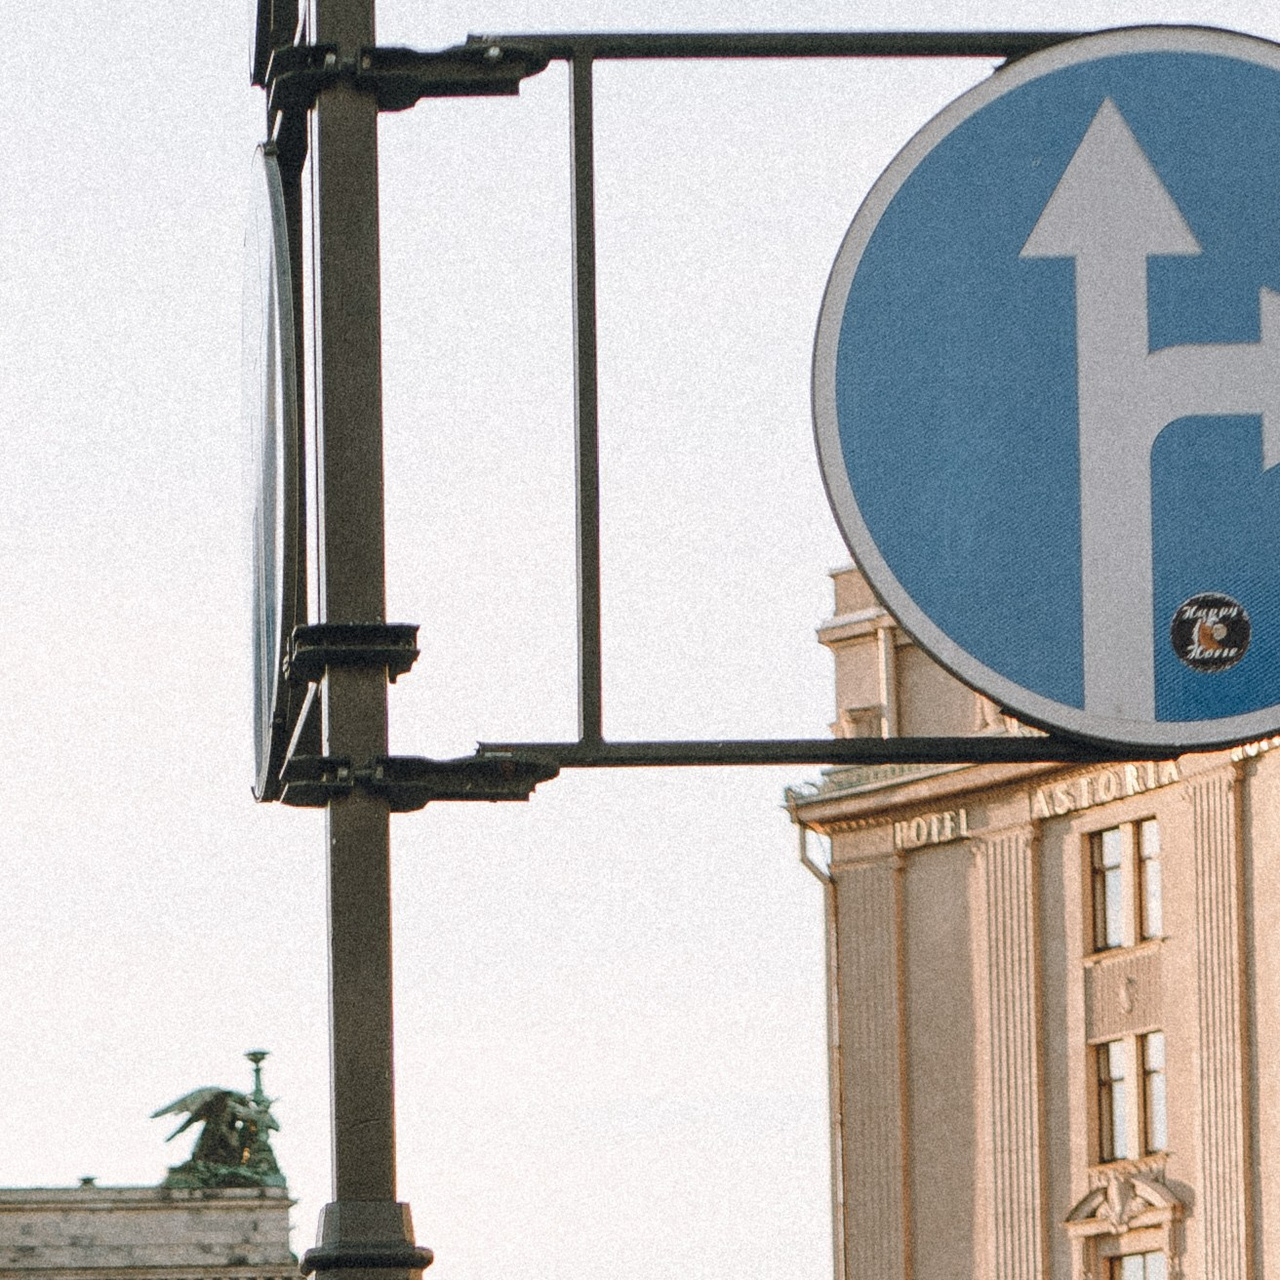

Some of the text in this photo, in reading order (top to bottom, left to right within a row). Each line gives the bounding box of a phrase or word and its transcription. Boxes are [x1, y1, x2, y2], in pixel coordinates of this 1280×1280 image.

[1182, 605, 1239, 624] Happy
[894, 760, 1180, 849] HOTEL ASTORIA
